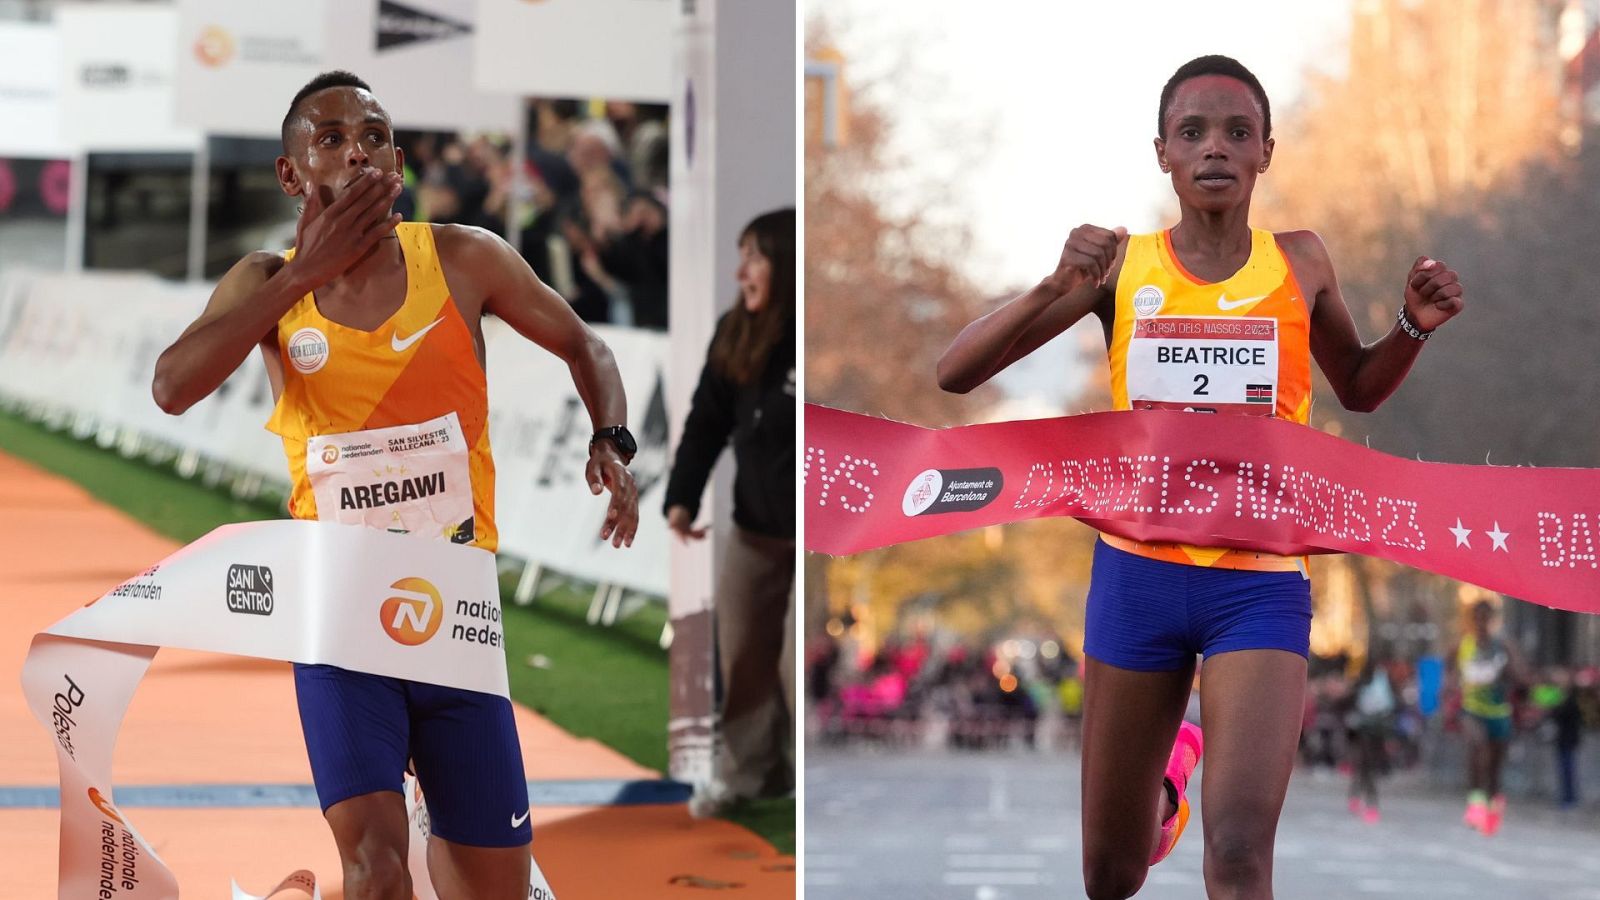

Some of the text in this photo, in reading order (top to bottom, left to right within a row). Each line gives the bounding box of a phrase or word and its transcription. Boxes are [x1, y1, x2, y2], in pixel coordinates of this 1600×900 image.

[1179, 322, 1201, 334] DELS
[1204, 322, 1242, 335] NASSOS
[1244, 324, 1270, 336] 2023
[1157, 346, 1266, 366] BEATRICE
[1192, 374, 1210, 396] 2
[341, 442, 372, 452] nationale
[387, 428, 447, 447] SAN SILVESTRE
[388, 440, 436, 453] VALLECANA
[441, 435, 450, 443] 23
[341, 448, 384, 459] nederlanden
[340, 471, 446, 510] AREGAWI
[947, 479, 994, 492] Ajuntament de
[941, 491, 988, 503] Barcelona
[1113, 455, 1220, 514] DELS
[1235, 461, 1371, 542] NASSOS
[1377, 496, 1426, 551] 23
[1537, 511, 1600, 569] BA
[229, 568, 255, 590] SANI
[229, 591, 273, 613] CENTRO
[99, 820, 119, 900] nederlande
[121, 828, 139, 891] nationale
